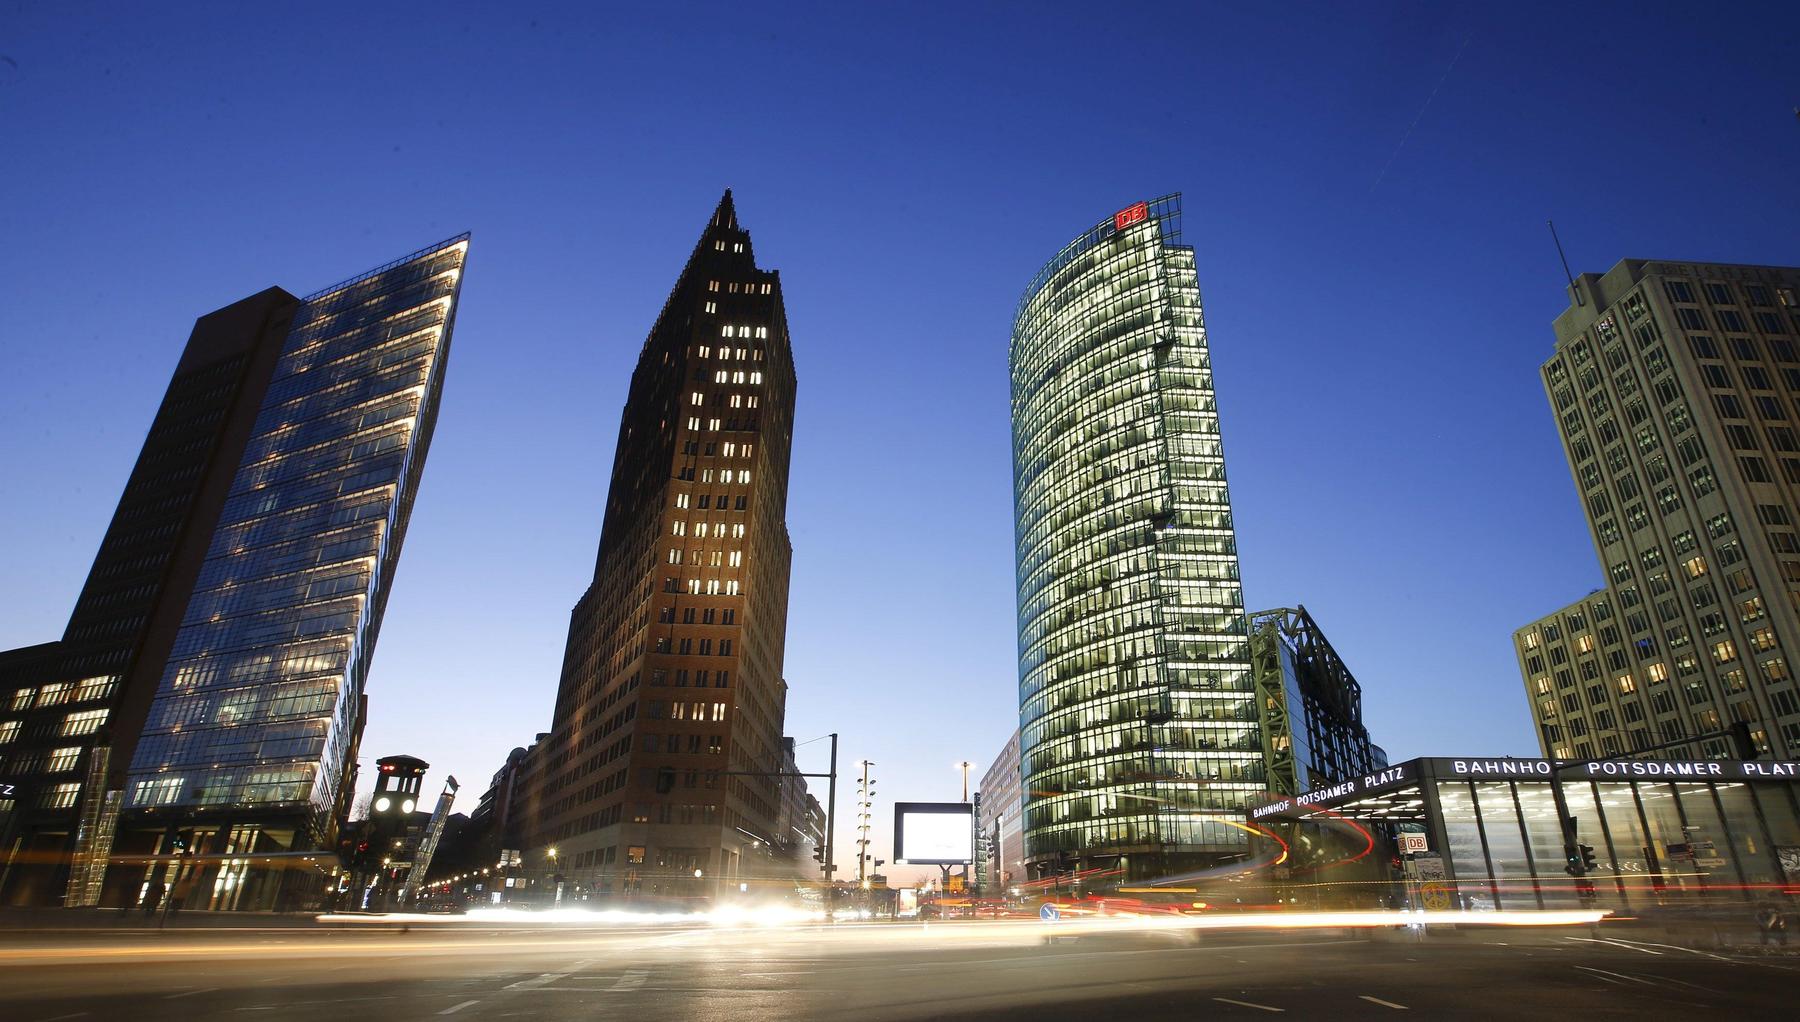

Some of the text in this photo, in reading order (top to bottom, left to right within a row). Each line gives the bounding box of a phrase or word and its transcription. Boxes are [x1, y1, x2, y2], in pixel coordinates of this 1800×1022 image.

[1118, 204, 1146, 226] DB
[1588, 762, 1722, 775] POTSDAMER
[1743, 763, 1800, 776] PLAT
[1253, 767, 1404, 818] BAHNHOF POTSDAMER PLATZ
[1408, 838, 1425, 849] DB
